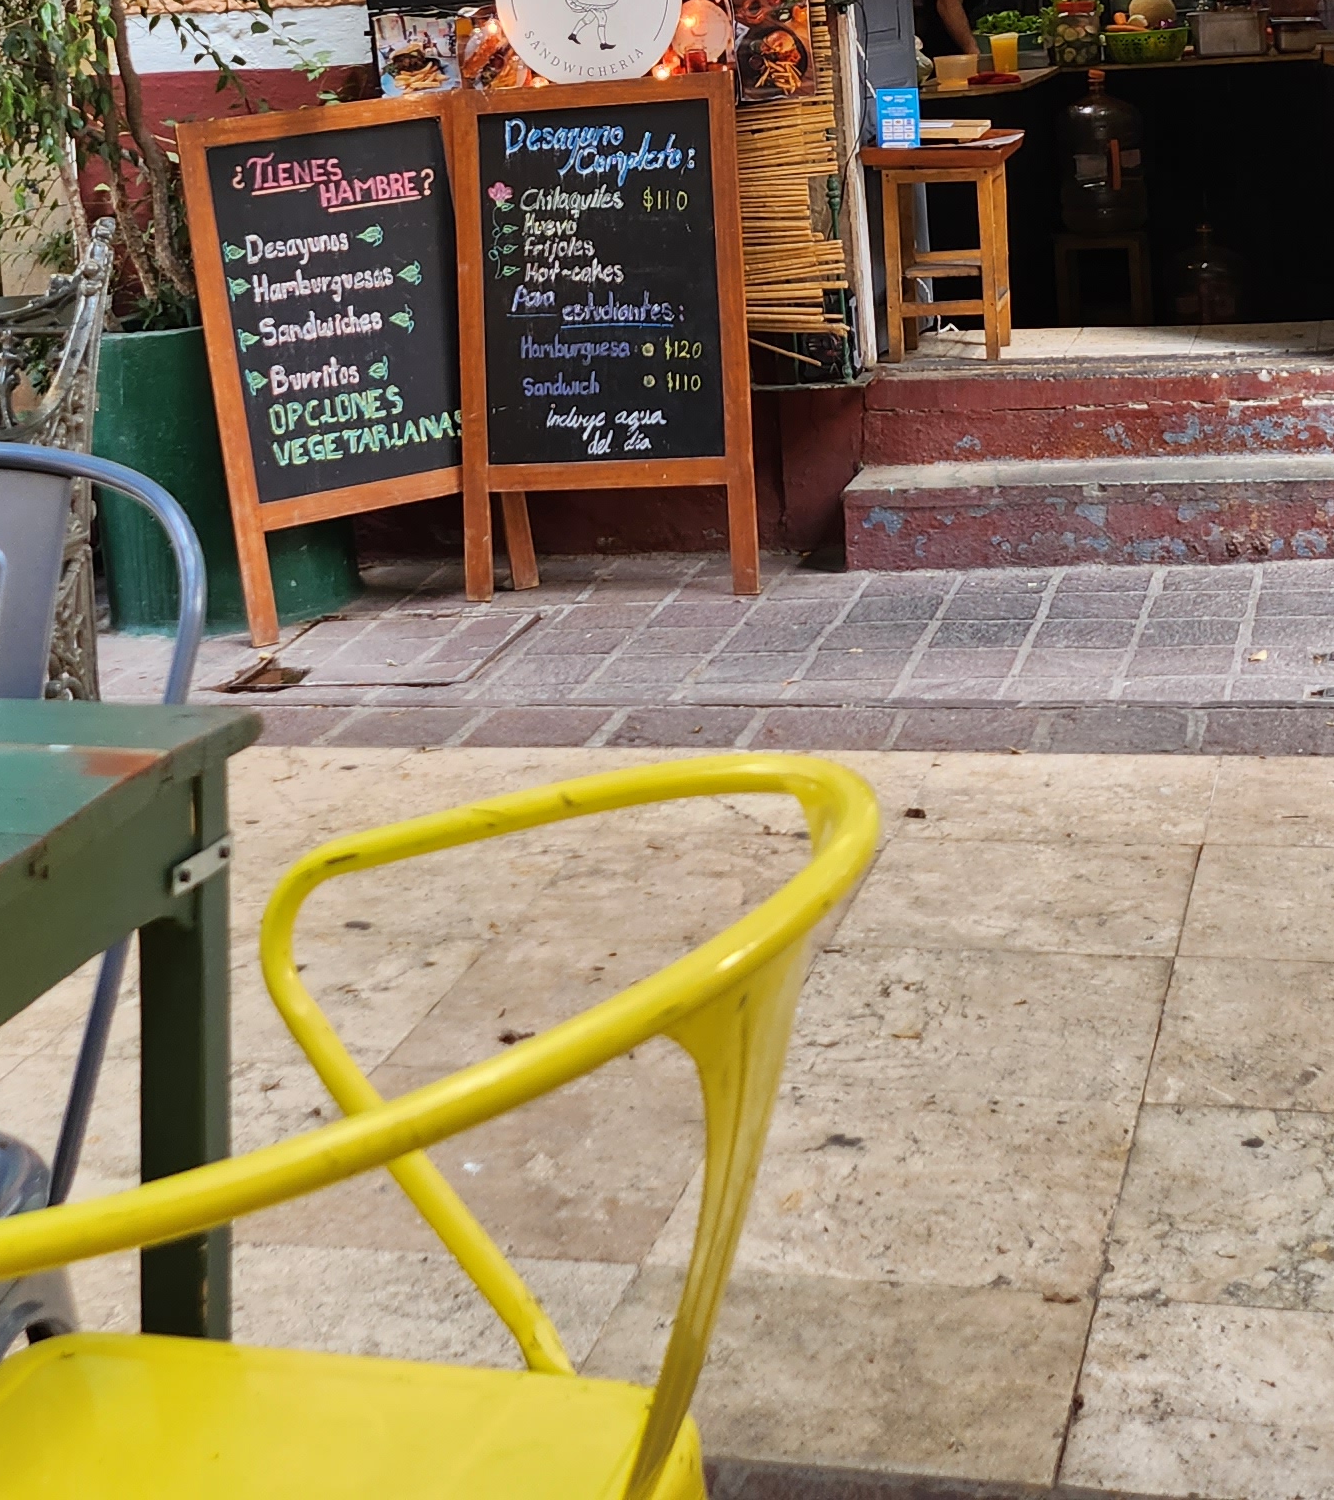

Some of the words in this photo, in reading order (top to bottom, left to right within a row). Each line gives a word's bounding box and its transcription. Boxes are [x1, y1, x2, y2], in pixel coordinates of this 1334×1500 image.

[524, 30, 644, 77] SANDWICHERIA
[319, 167, 436, 208] HAMBRE?
[519, 184, 625, 212] Chilaquiles
[642, 186, 688, 212] $110
[244, 231, 350, 265] Desayunos
[252, 266, 395, 302] Hamburguesas
[258, 305, 384, 347] Sandwiches
[520, 334, 631, 366] Hamburguesa
[664, 335, 703, 361] $120
[269, 356, 360, 396] Burritos
[522, 370, 601, 396] Sandwich
[667, 371, 702, 393] $110
[268, 384, 404, 435] OPCIONES
[614, 409, 668, 434] agua
[587, 430, 614, 455] del
